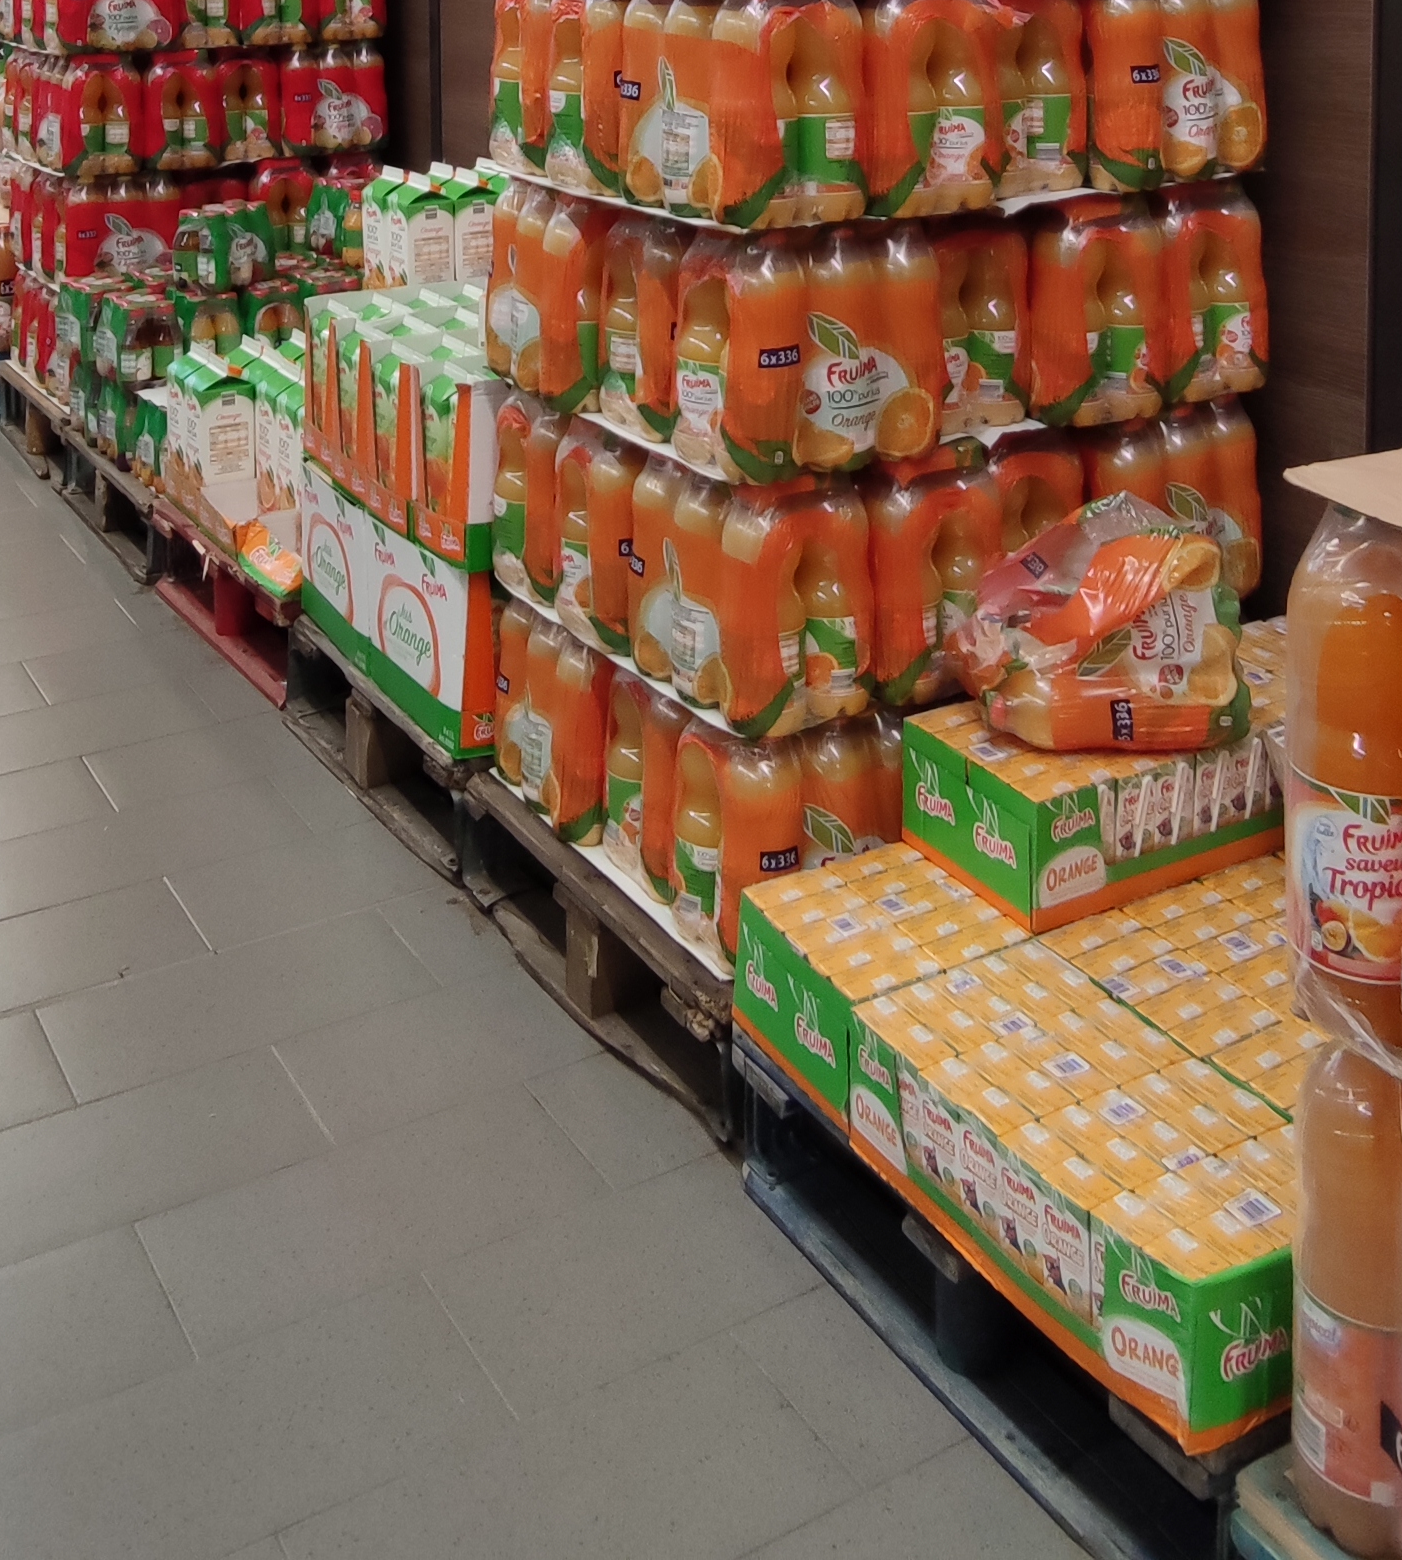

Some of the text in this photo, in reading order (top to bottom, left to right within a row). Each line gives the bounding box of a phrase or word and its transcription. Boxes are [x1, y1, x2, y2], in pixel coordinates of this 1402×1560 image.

[938, 123, 966, 135] RUIMA
[760, 348, 798, 366] 6x336
[827, 355, 878, 388] FRUIMA
[681, 374, 711, 389] FRUIMA
[831, 410, 877, 431] Orange
[374, 542, 396, 568] FRUIMA
[421, 573, 447, 602] FRUIMA
[1182, 593, 1197, 653] Orange
[917, 783, 955, 825] FRUIMA
[1052, 809, 1094, 841] FRUIMA
[761, 851, 797, 869] 6x336
[974, 824, 1017, 869] FRUIMA
[1345, 858, 1402, 872] saveu
[1046, 854, 1098, 892] ORANGE
[747, 962, 778, 1011] FRUIMA
[796, 1014, 836, 1068] FRUIMA
[859, 1047, 892, 1093] FRUIMA
[855, 1093, 897, 1147] ORANGE
[923, 1100, 954, 1135] FRUIMA
[963, 1130, 996, 1168] FRUIMA
[1001, 1167, 1037, 1205] FRUIMA
[1044, 1204, 1082, 1244] FRUIMA
[1120, 1273, 1181, 1323] FRUIMA
[1221, 1327, 1288, 1381] FRUIMA
